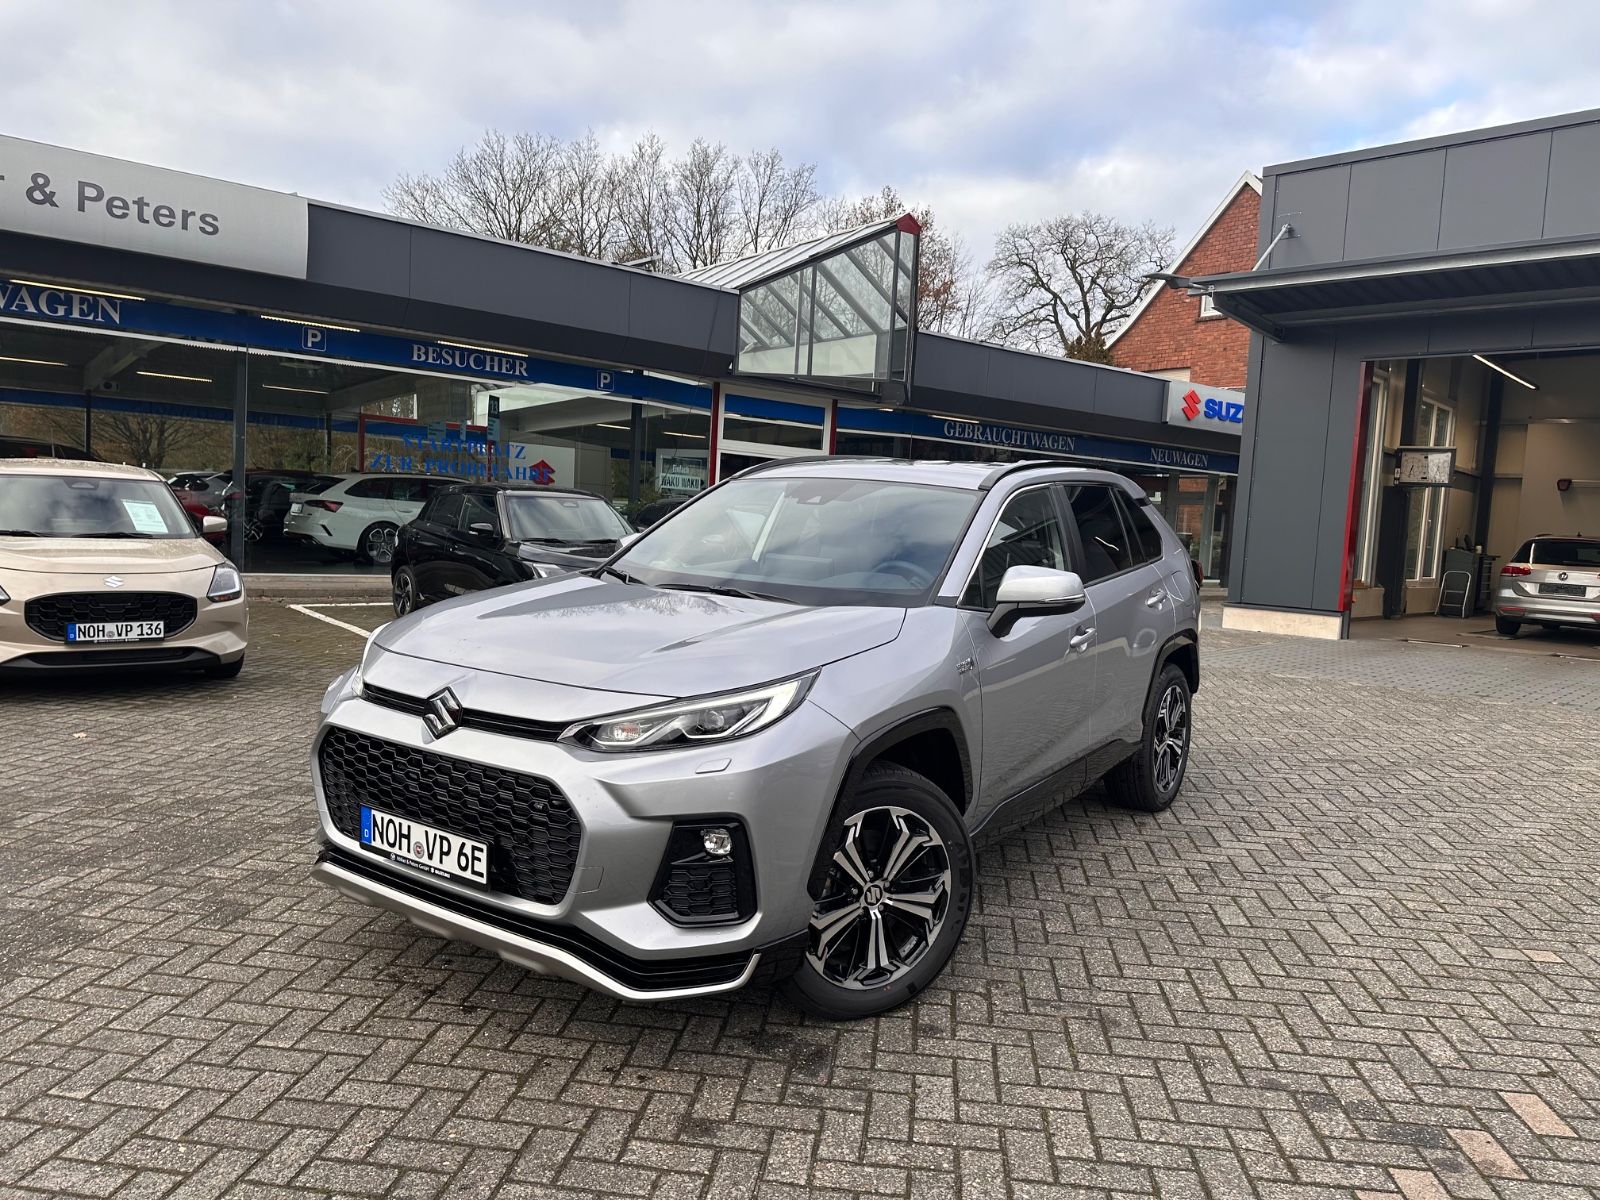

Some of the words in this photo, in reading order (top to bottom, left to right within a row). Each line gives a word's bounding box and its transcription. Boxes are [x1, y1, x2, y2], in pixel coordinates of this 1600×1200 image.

[26, 172, 59, 207] &
[77, 180, 220, 236] Peters
[307, 330, 322, 347] P
[411, 343, 529, 377] BESUCHER
[600, 371, 611, 388] P
[943, 420, 1076, 451] GEBRAUCHTWAGEN
[1150, 447, 1209, 468] NEUWAGEN
[77, 624, 106, 639] NOH
[115, 623, 133, 638] VP
[136, 622, 162, 637] 136
[372, 813, 411, 854] NOH
[424, 829, 452, 865] VP
[456, 841, 485, 879] 6E
